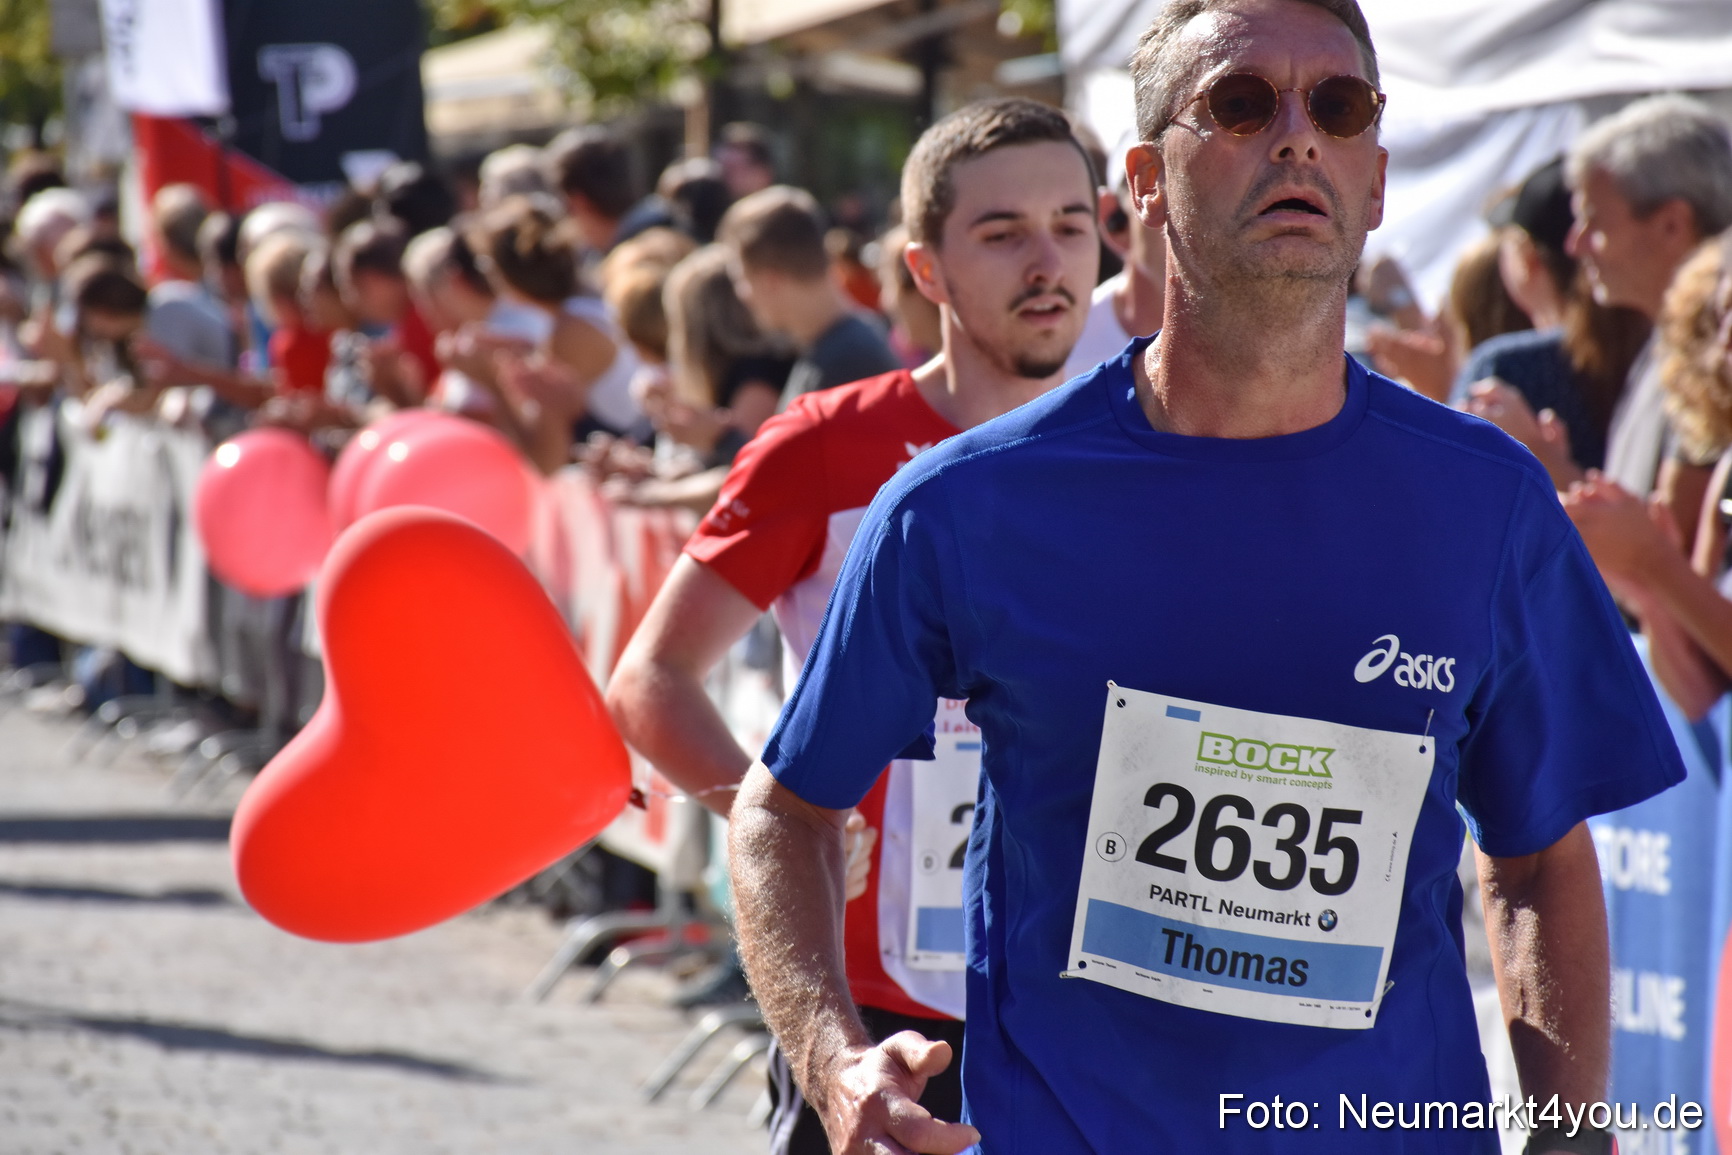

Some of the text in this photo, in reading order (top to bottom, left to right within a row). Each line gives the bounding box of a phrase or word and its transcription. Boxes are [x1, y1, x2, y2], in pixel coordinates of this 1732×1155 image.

[1194, 762, 1333, 790] inspired by smart concepts
[1197, 731, 1336, 778] BOCK
[1105, 839, 1117, 855] B
[1135, 782, 1363, 896] 2635
[1150, 884, 1312, 927] PARTL Neumarkt
[1161, 927, 1310, 988] Thomas
